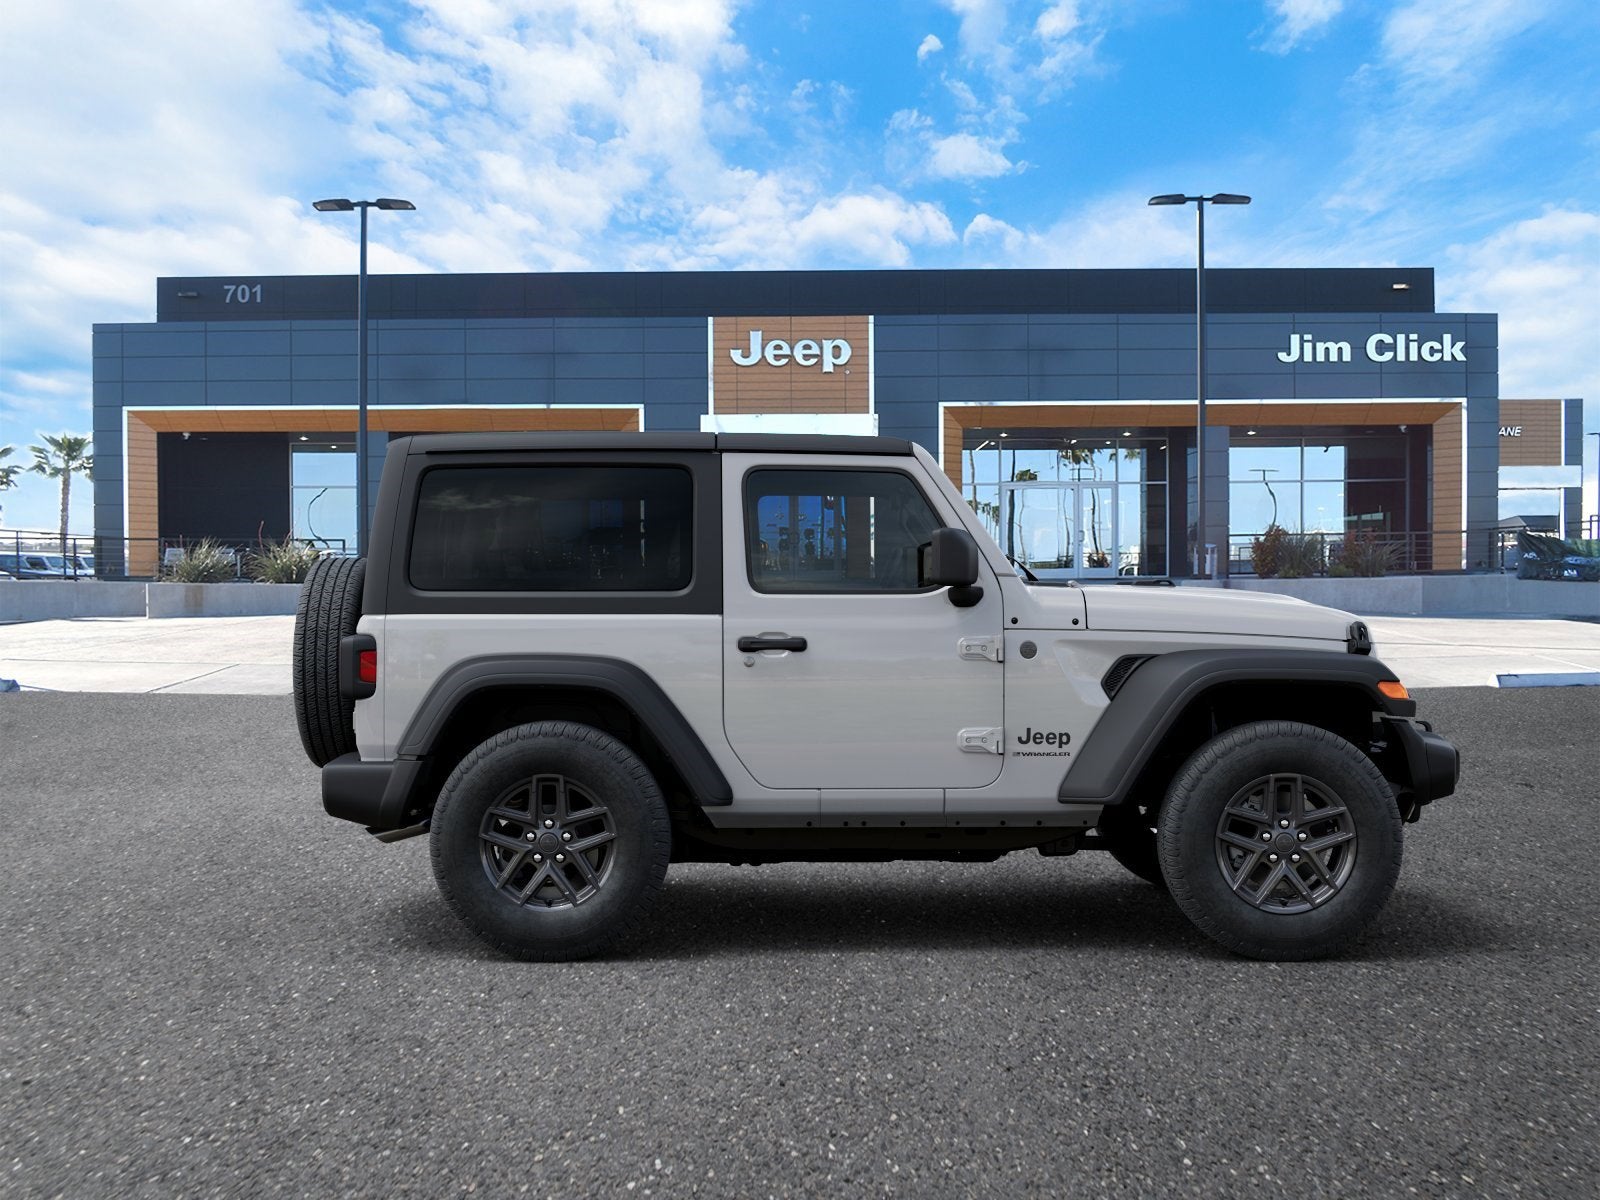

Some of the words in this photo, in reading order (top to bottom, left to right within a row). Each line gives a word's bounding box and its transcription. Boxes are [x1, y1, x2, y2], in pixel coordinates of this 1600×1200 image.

[223, 284, 263, 303] 701
[730, 330, 852, 373] Jeep
[1277, 333, 1351, 362] Jim
[1366, 333, 1467, 362] Click
[1017, 727, 1071, 749] Jeep
